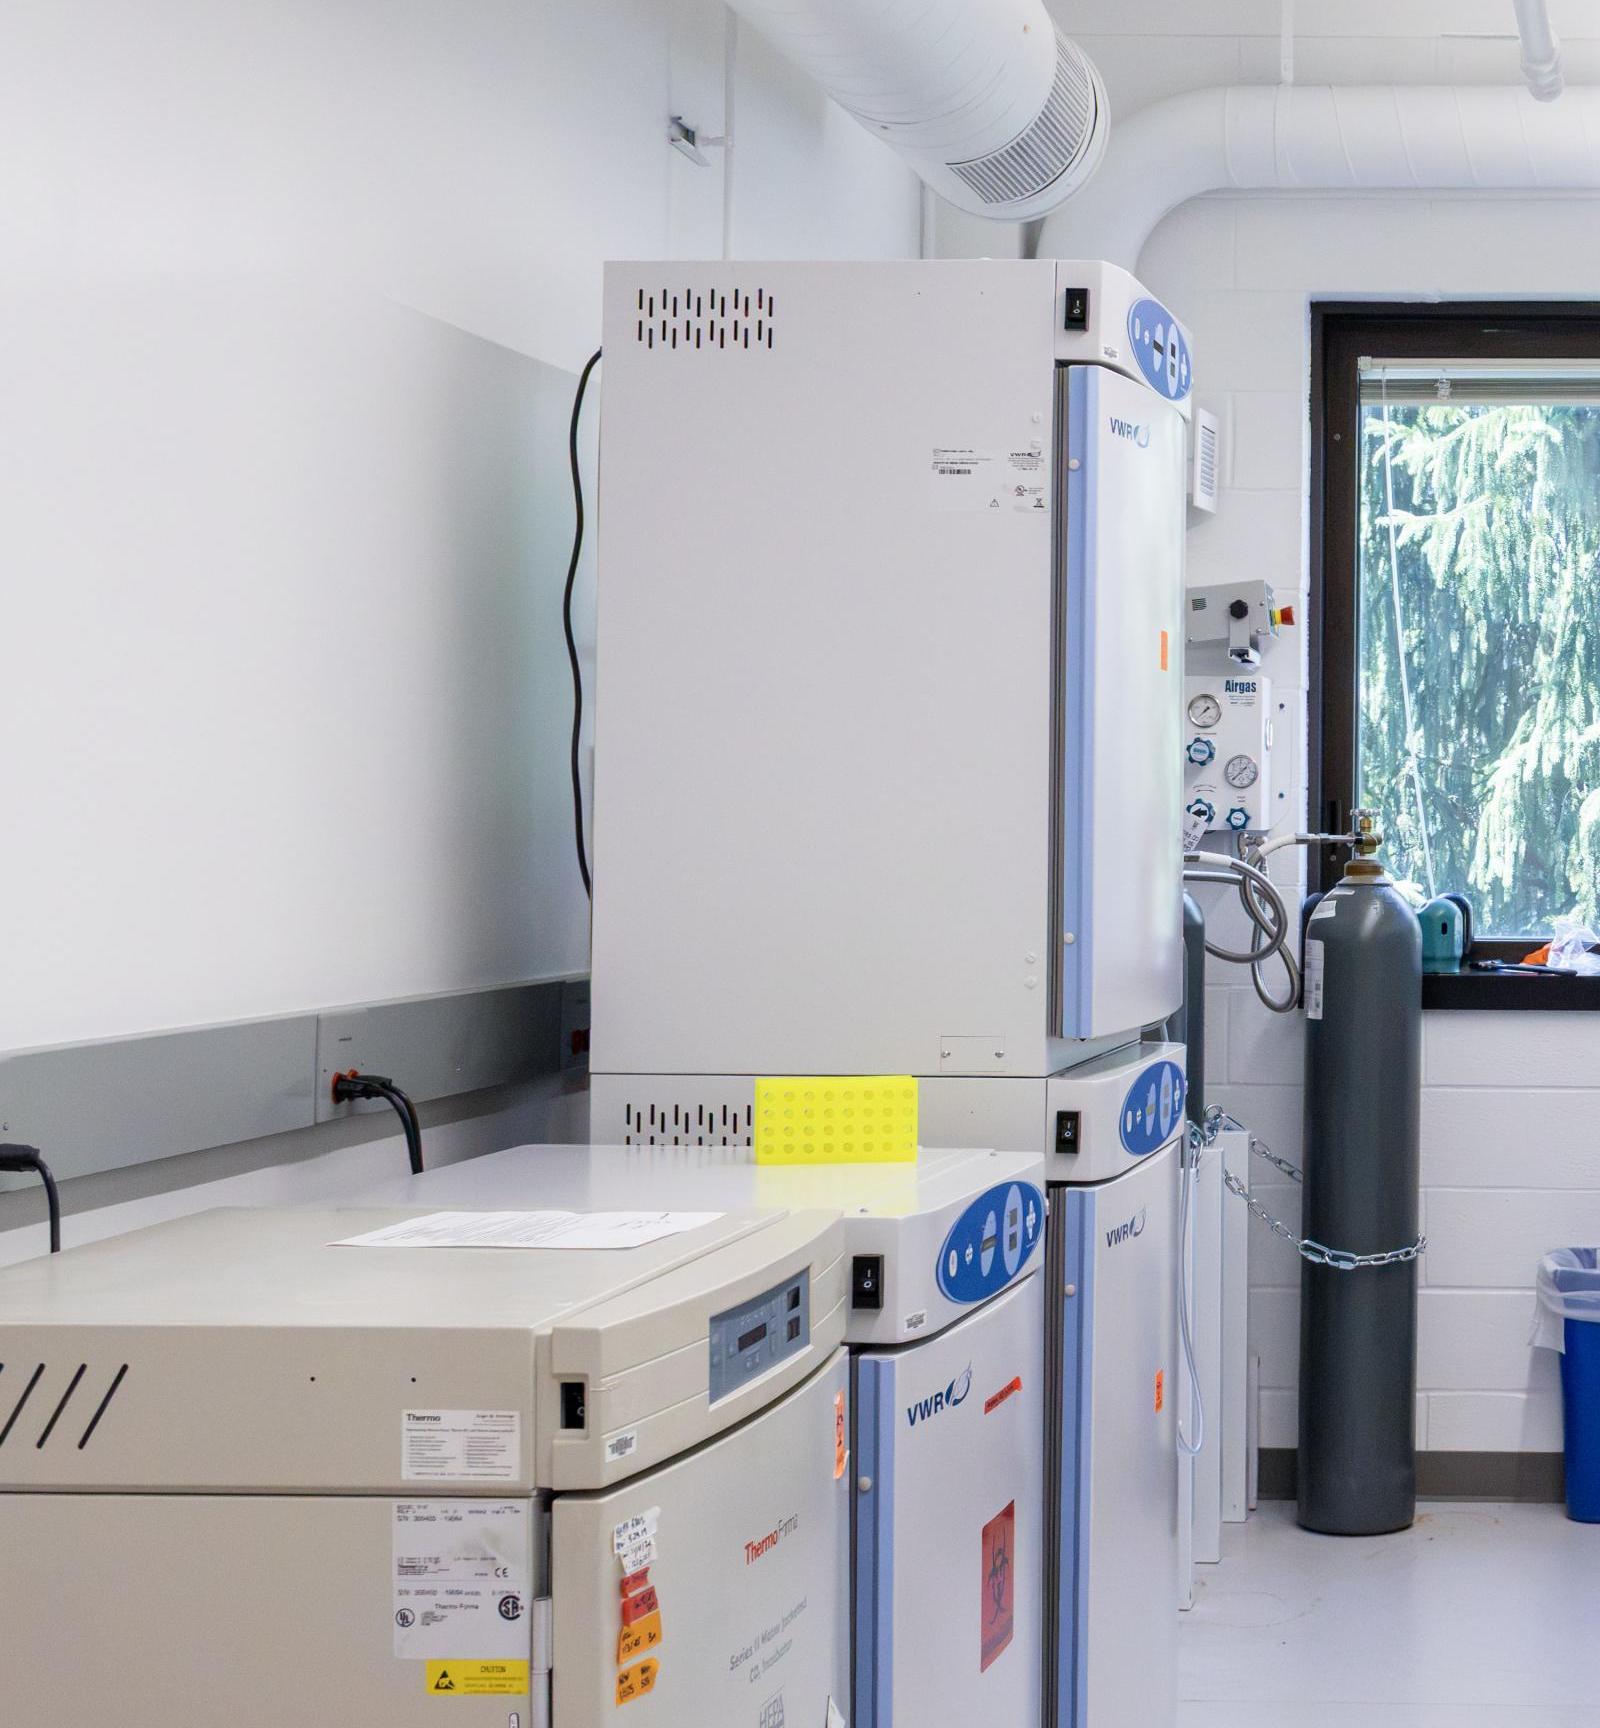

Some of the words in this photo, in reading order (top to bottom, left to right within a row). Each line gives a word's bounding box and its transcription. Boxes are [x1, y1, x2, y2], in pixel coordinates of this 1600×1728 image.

[1110, 417, 1134, 440] VWR
[1225, 680, 1257, 694] Airgas
[1106, 1225, 1129, 1248] VWR
[406, 1413, 441, 1422] Thermo
[907, 1392, 944, 1427] VWR
